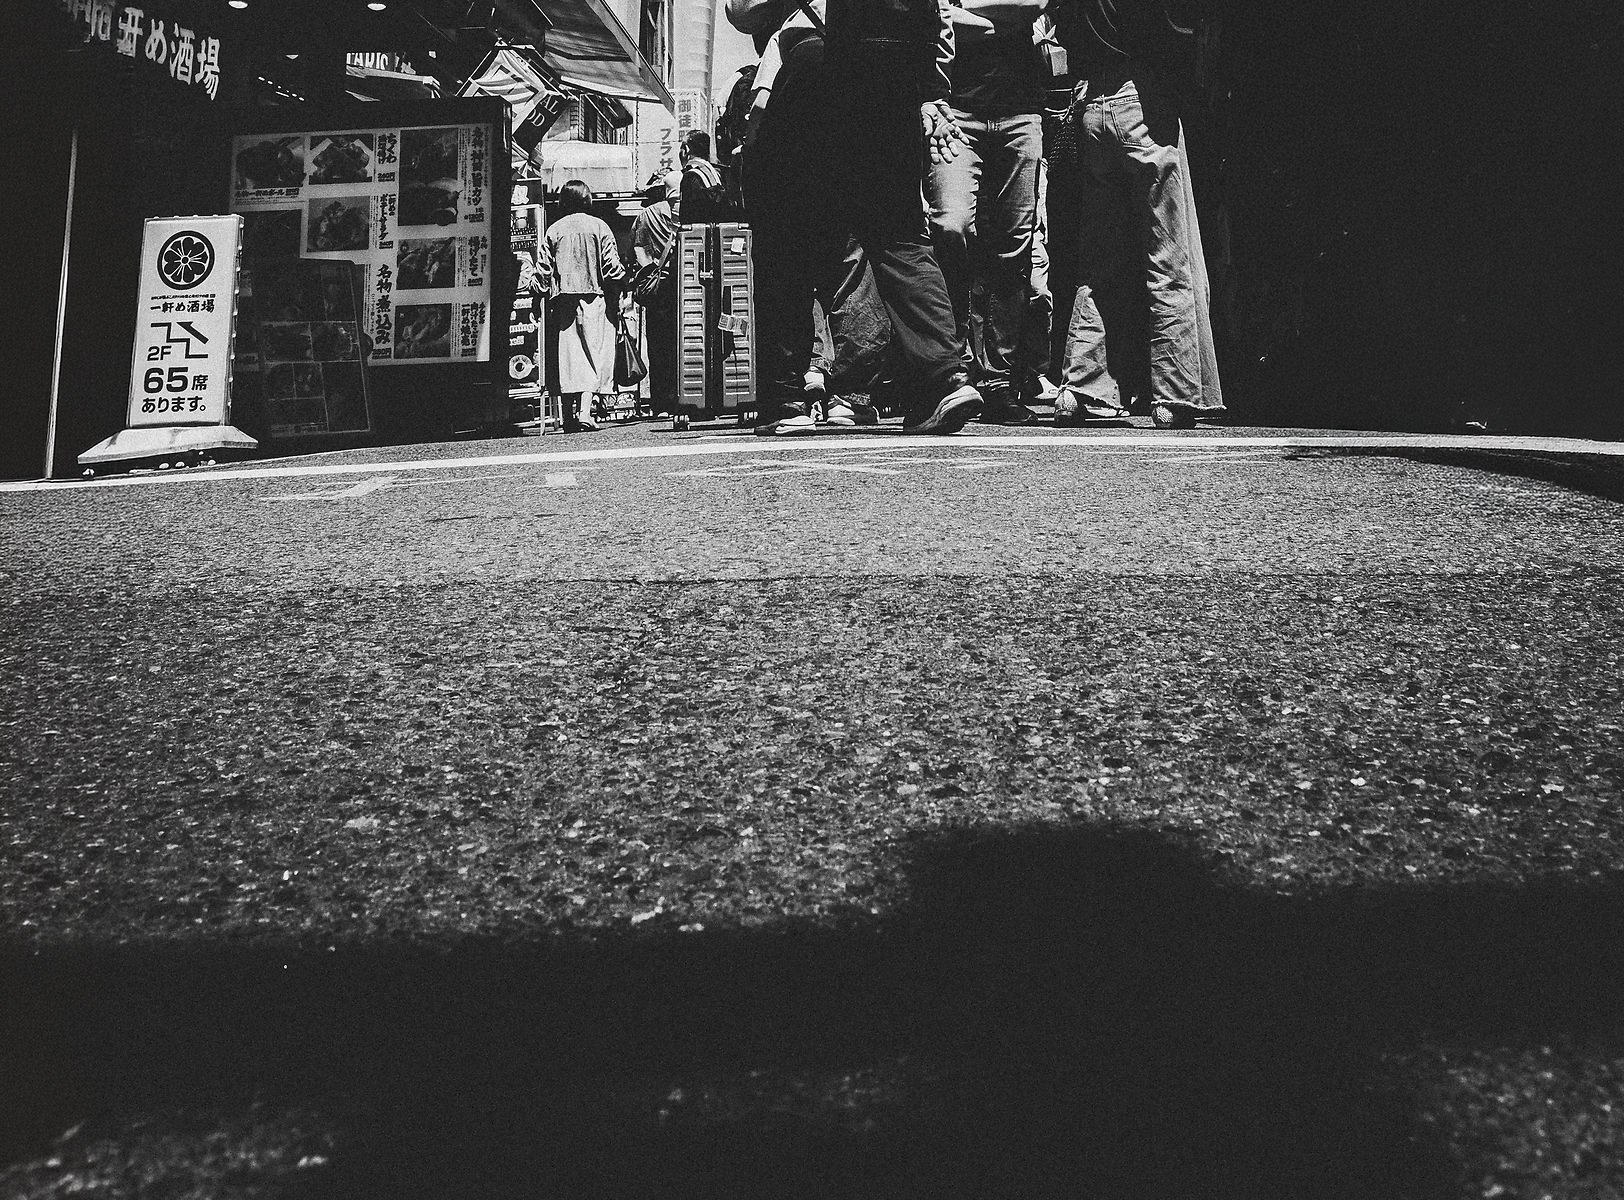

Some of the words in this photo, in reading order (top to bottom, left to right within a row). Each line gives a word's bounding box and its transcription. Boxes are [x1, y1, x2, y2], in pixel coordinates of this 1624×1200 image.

[150, 299, 215, 313] 一軒め酒場
[147, 345, 172, 361] 2F
[143, 366, 209, 393] 65席
[141, 395, 207, 414] あります。
